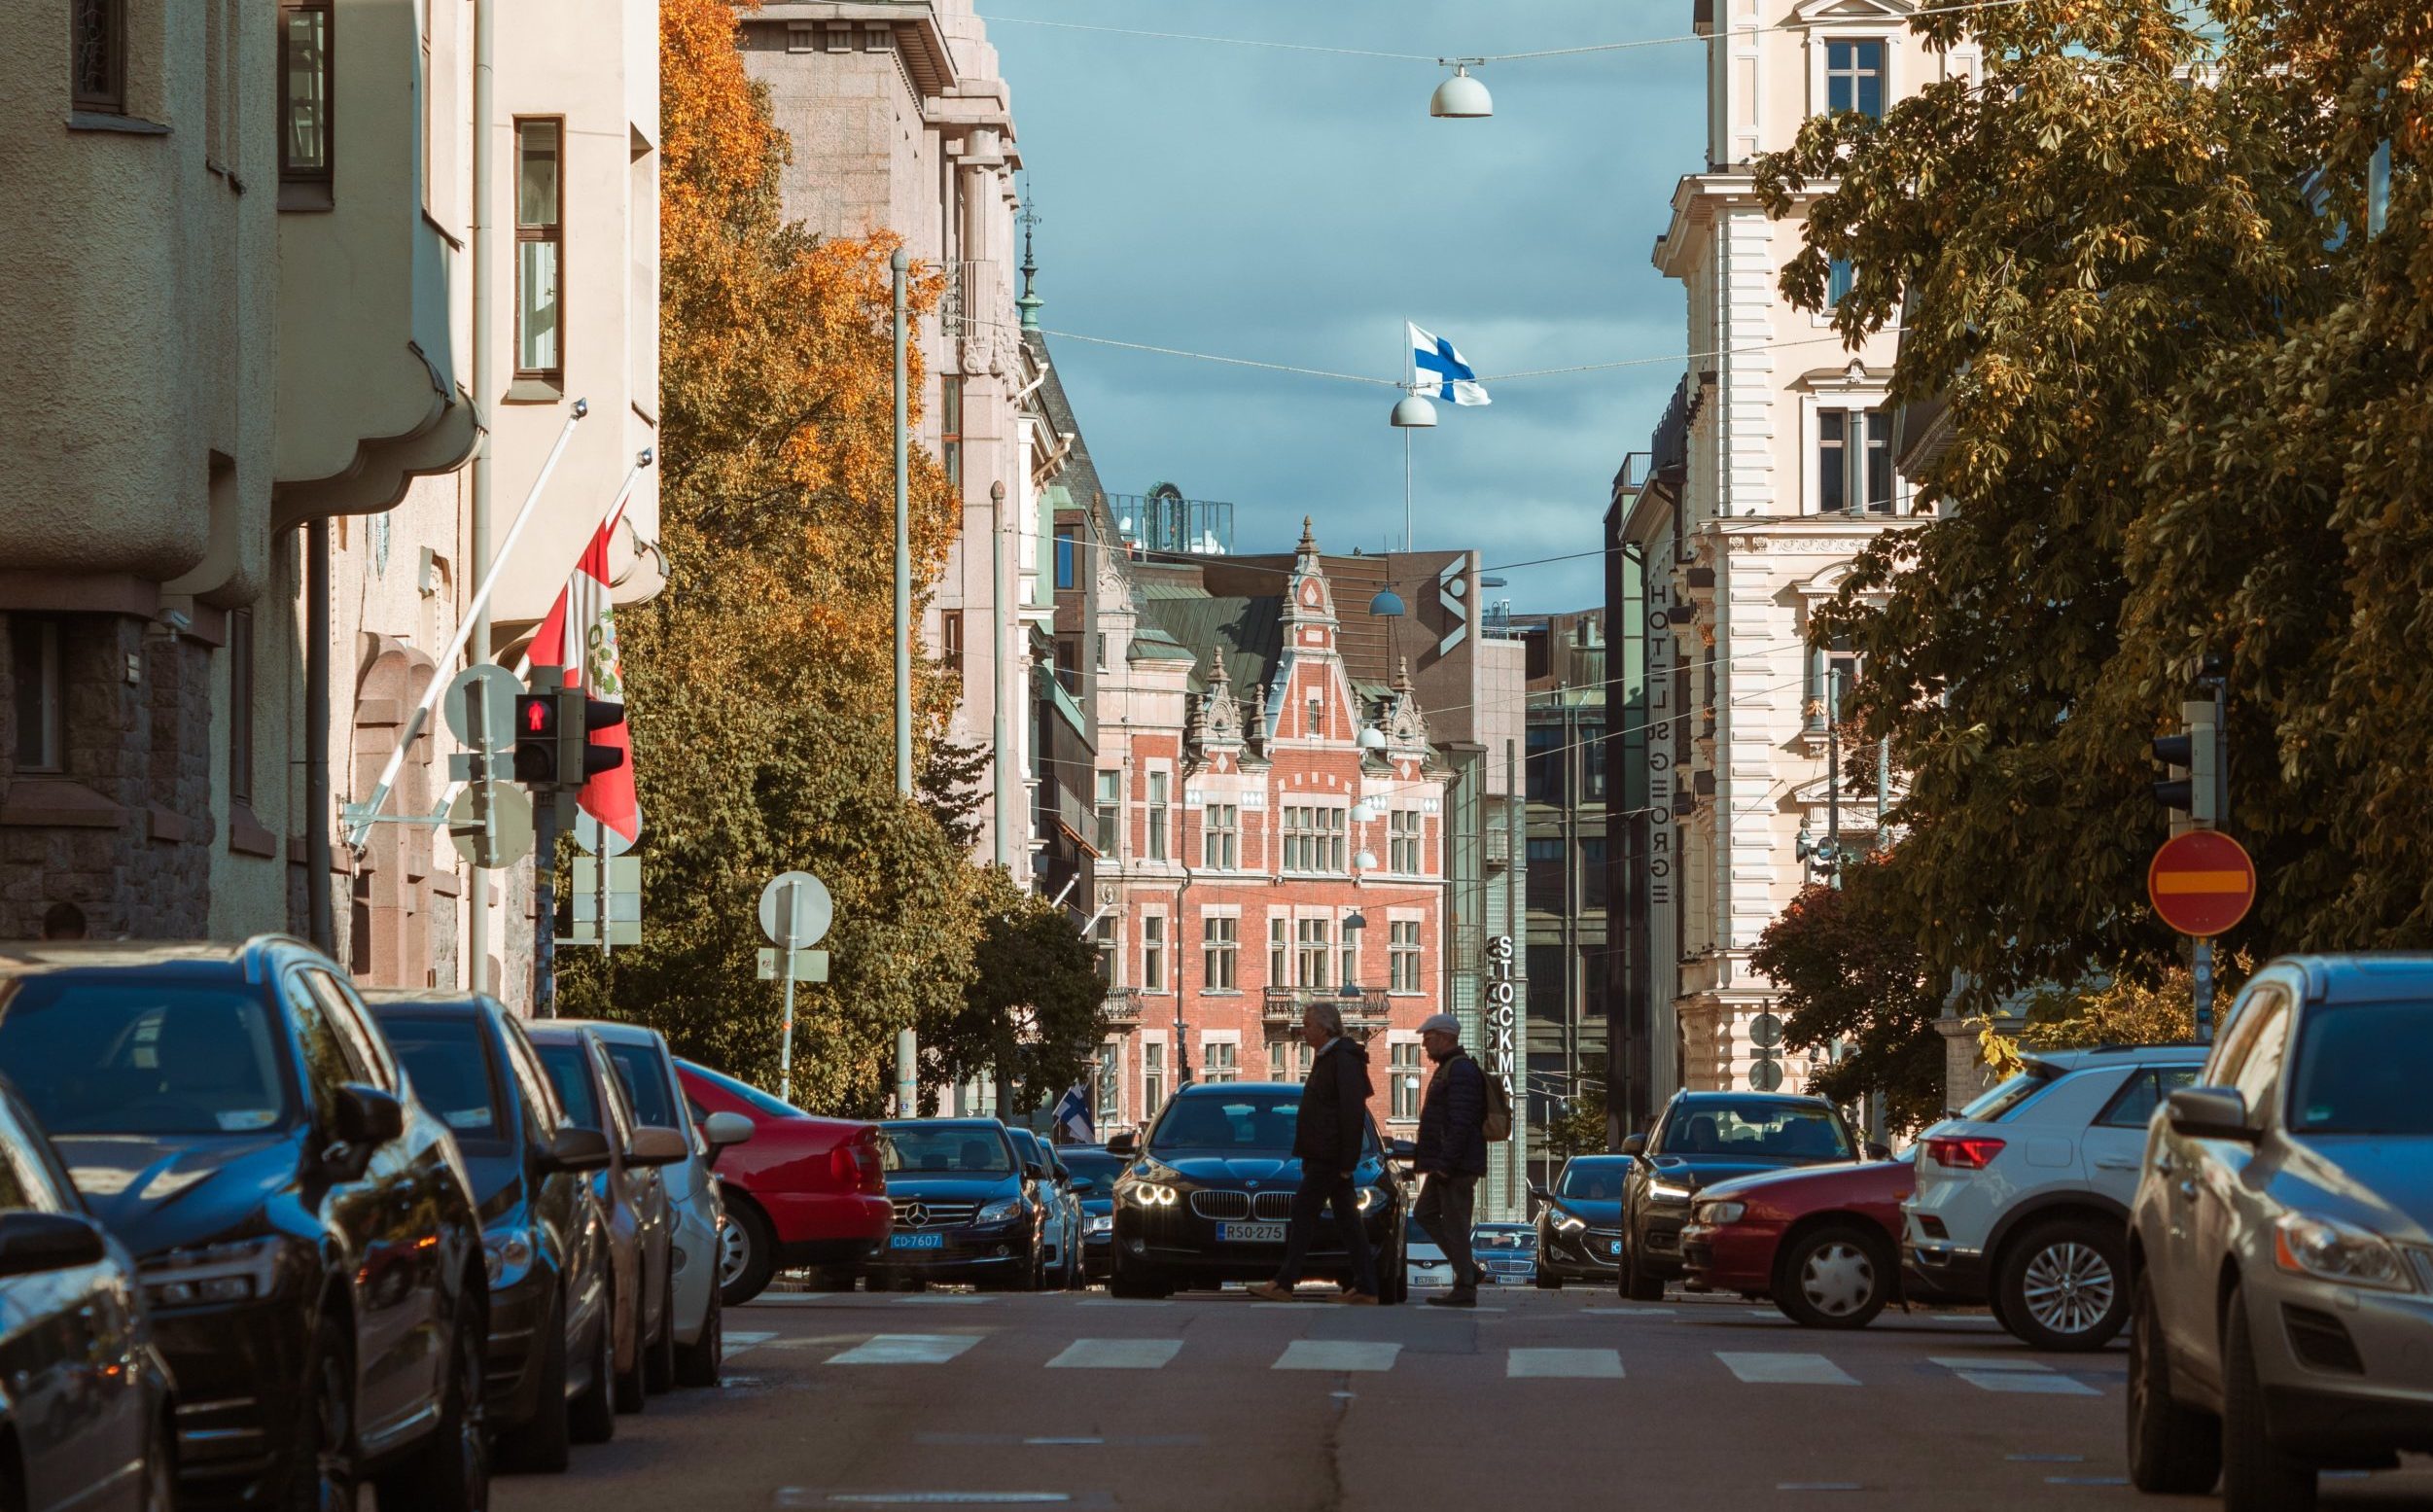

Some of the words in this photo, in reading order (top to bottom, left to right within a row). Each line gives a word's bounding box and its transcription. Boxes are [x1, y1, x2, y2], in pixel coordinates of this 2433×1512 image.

[1499, 935, 1514, 1141] STOCKMA
[1226, 1226, 1283, 1239] RSO-275
[894, 1236, 939, 1247] CD-7607
